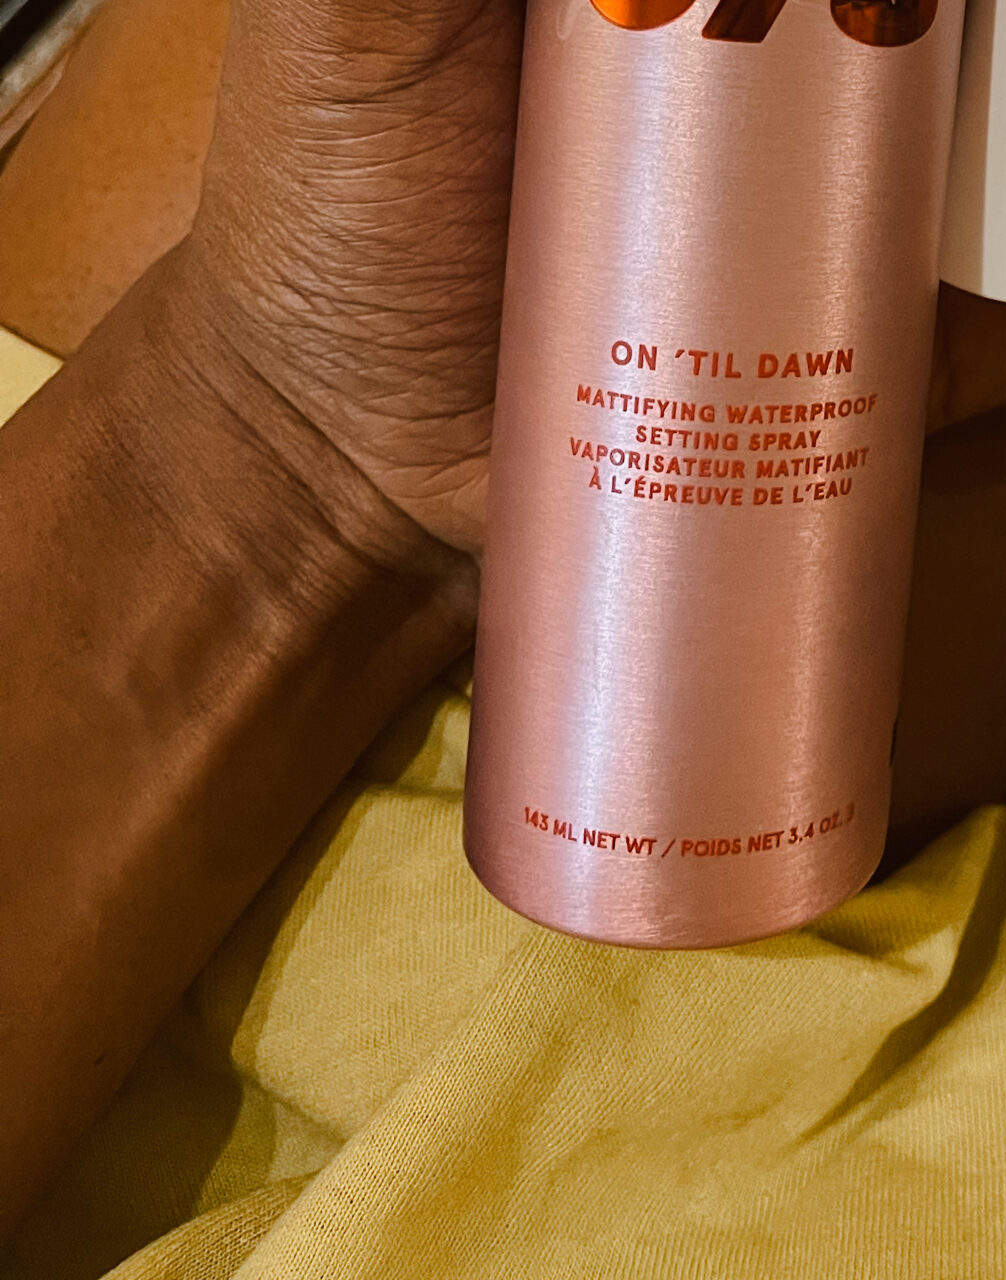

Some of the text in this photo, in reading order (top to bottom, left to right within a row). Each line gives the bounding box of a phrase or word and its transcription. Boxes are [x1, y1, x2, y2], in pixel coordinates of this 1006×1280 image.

[611, 340, 658, 371] ON
[758, 348, 854, 379] DAWN
[576, 384, 879, 425] MATTIFYING WATERPROOF
[569, 436, 870, 479] VAPORISATEUR MATIFIANT
[635, 425, 821, 452] SETTING SPRAY
[752, 486, 784, 506] DE
[792, 477, 853, 504] L'EAU
[524, 806, 550, 833] 143
[552, 818, 578, 842] ML
[582, 830, 621, 851] NET
[625, 836, 657, 857] WT
[680, 839, 742, 857] POIDS
[747, 830, 785, 853] NET
[788, 822, 814, 845] 3.4
